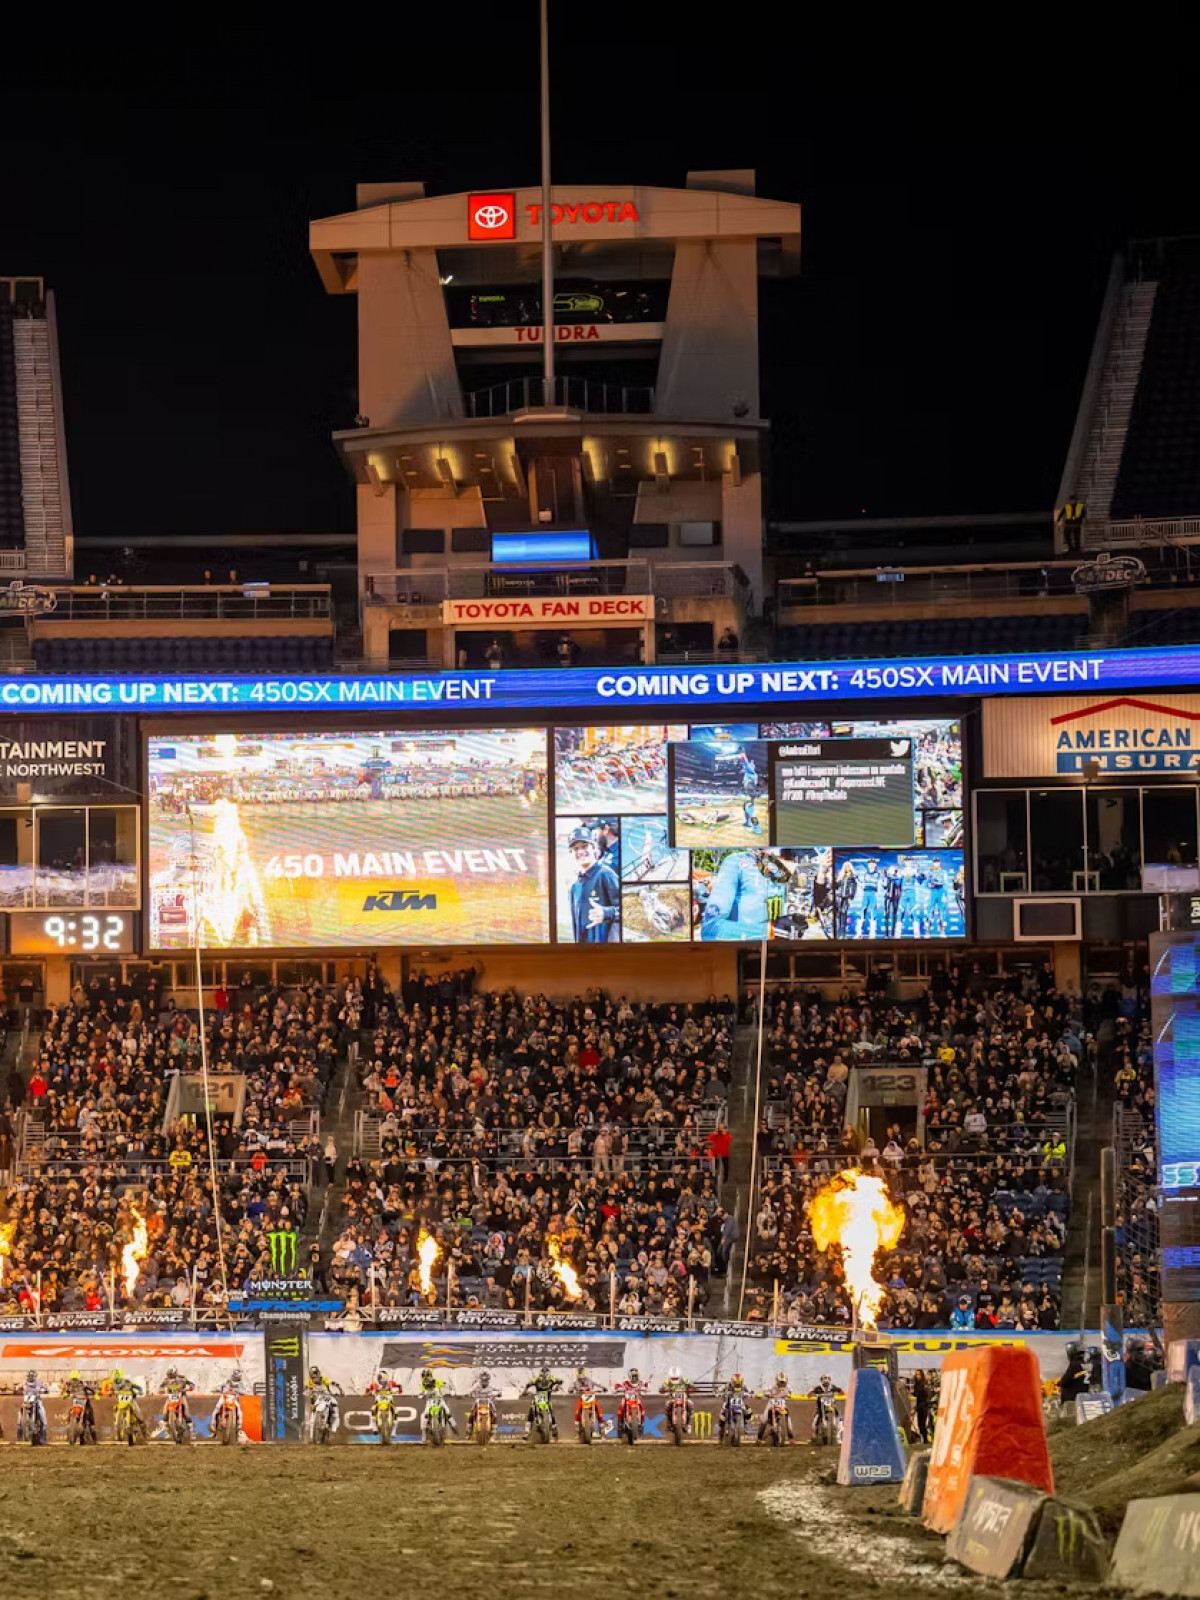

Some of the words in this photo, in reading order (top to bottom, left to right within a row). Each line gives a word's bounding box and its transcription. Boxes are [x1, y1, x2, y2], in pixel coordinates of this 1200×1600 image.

[526, 201, 640, 226] TOYOTA
[514, 325, 600, 342] TUDRA
[453, 602, 534, 618] TOYOTA
[541, 601, 580, 617] FAN
[588, 599, 645, 615] DECK
[596, 674, 710, 699] COMING
[716, 673, 755, 696] UP
[761, 669, 839, 693] NEXT:
[849, 665, 935, 691] 450SX
[941, 662, 1011, 687] MAIN
[1017, 659, 1105, 684] EVENT
[1, 682, 110, 705] COMING
[119, 683, 157, 704] UP
[163, 682, 239, 703] NEXT:
[249, 681, 333, 703] 450SX
[338, 680, 405, 702] MAIN
[412, 679, 496, 701] EVENT
[1056, 727, 1192, 750] AMERICAN
[6, 762, 106, 777] NORTHWEST!
[264, 854, 324, 879] 450
[334, 851, 417, 877] MAIN
[424, 848, 530, 875] EVENT
[361, 888, 437, 912] KTM
[43, 915, 124, 950] 9:32
[187, 1081, 234, 1099] 121
[861, 1074, 916, 1092] 123
[251, 1279, 314, 1291] MONSTER
[72, 1347, 214, 1356] HONDA
[853, 1465, 892, 1478] WPS
